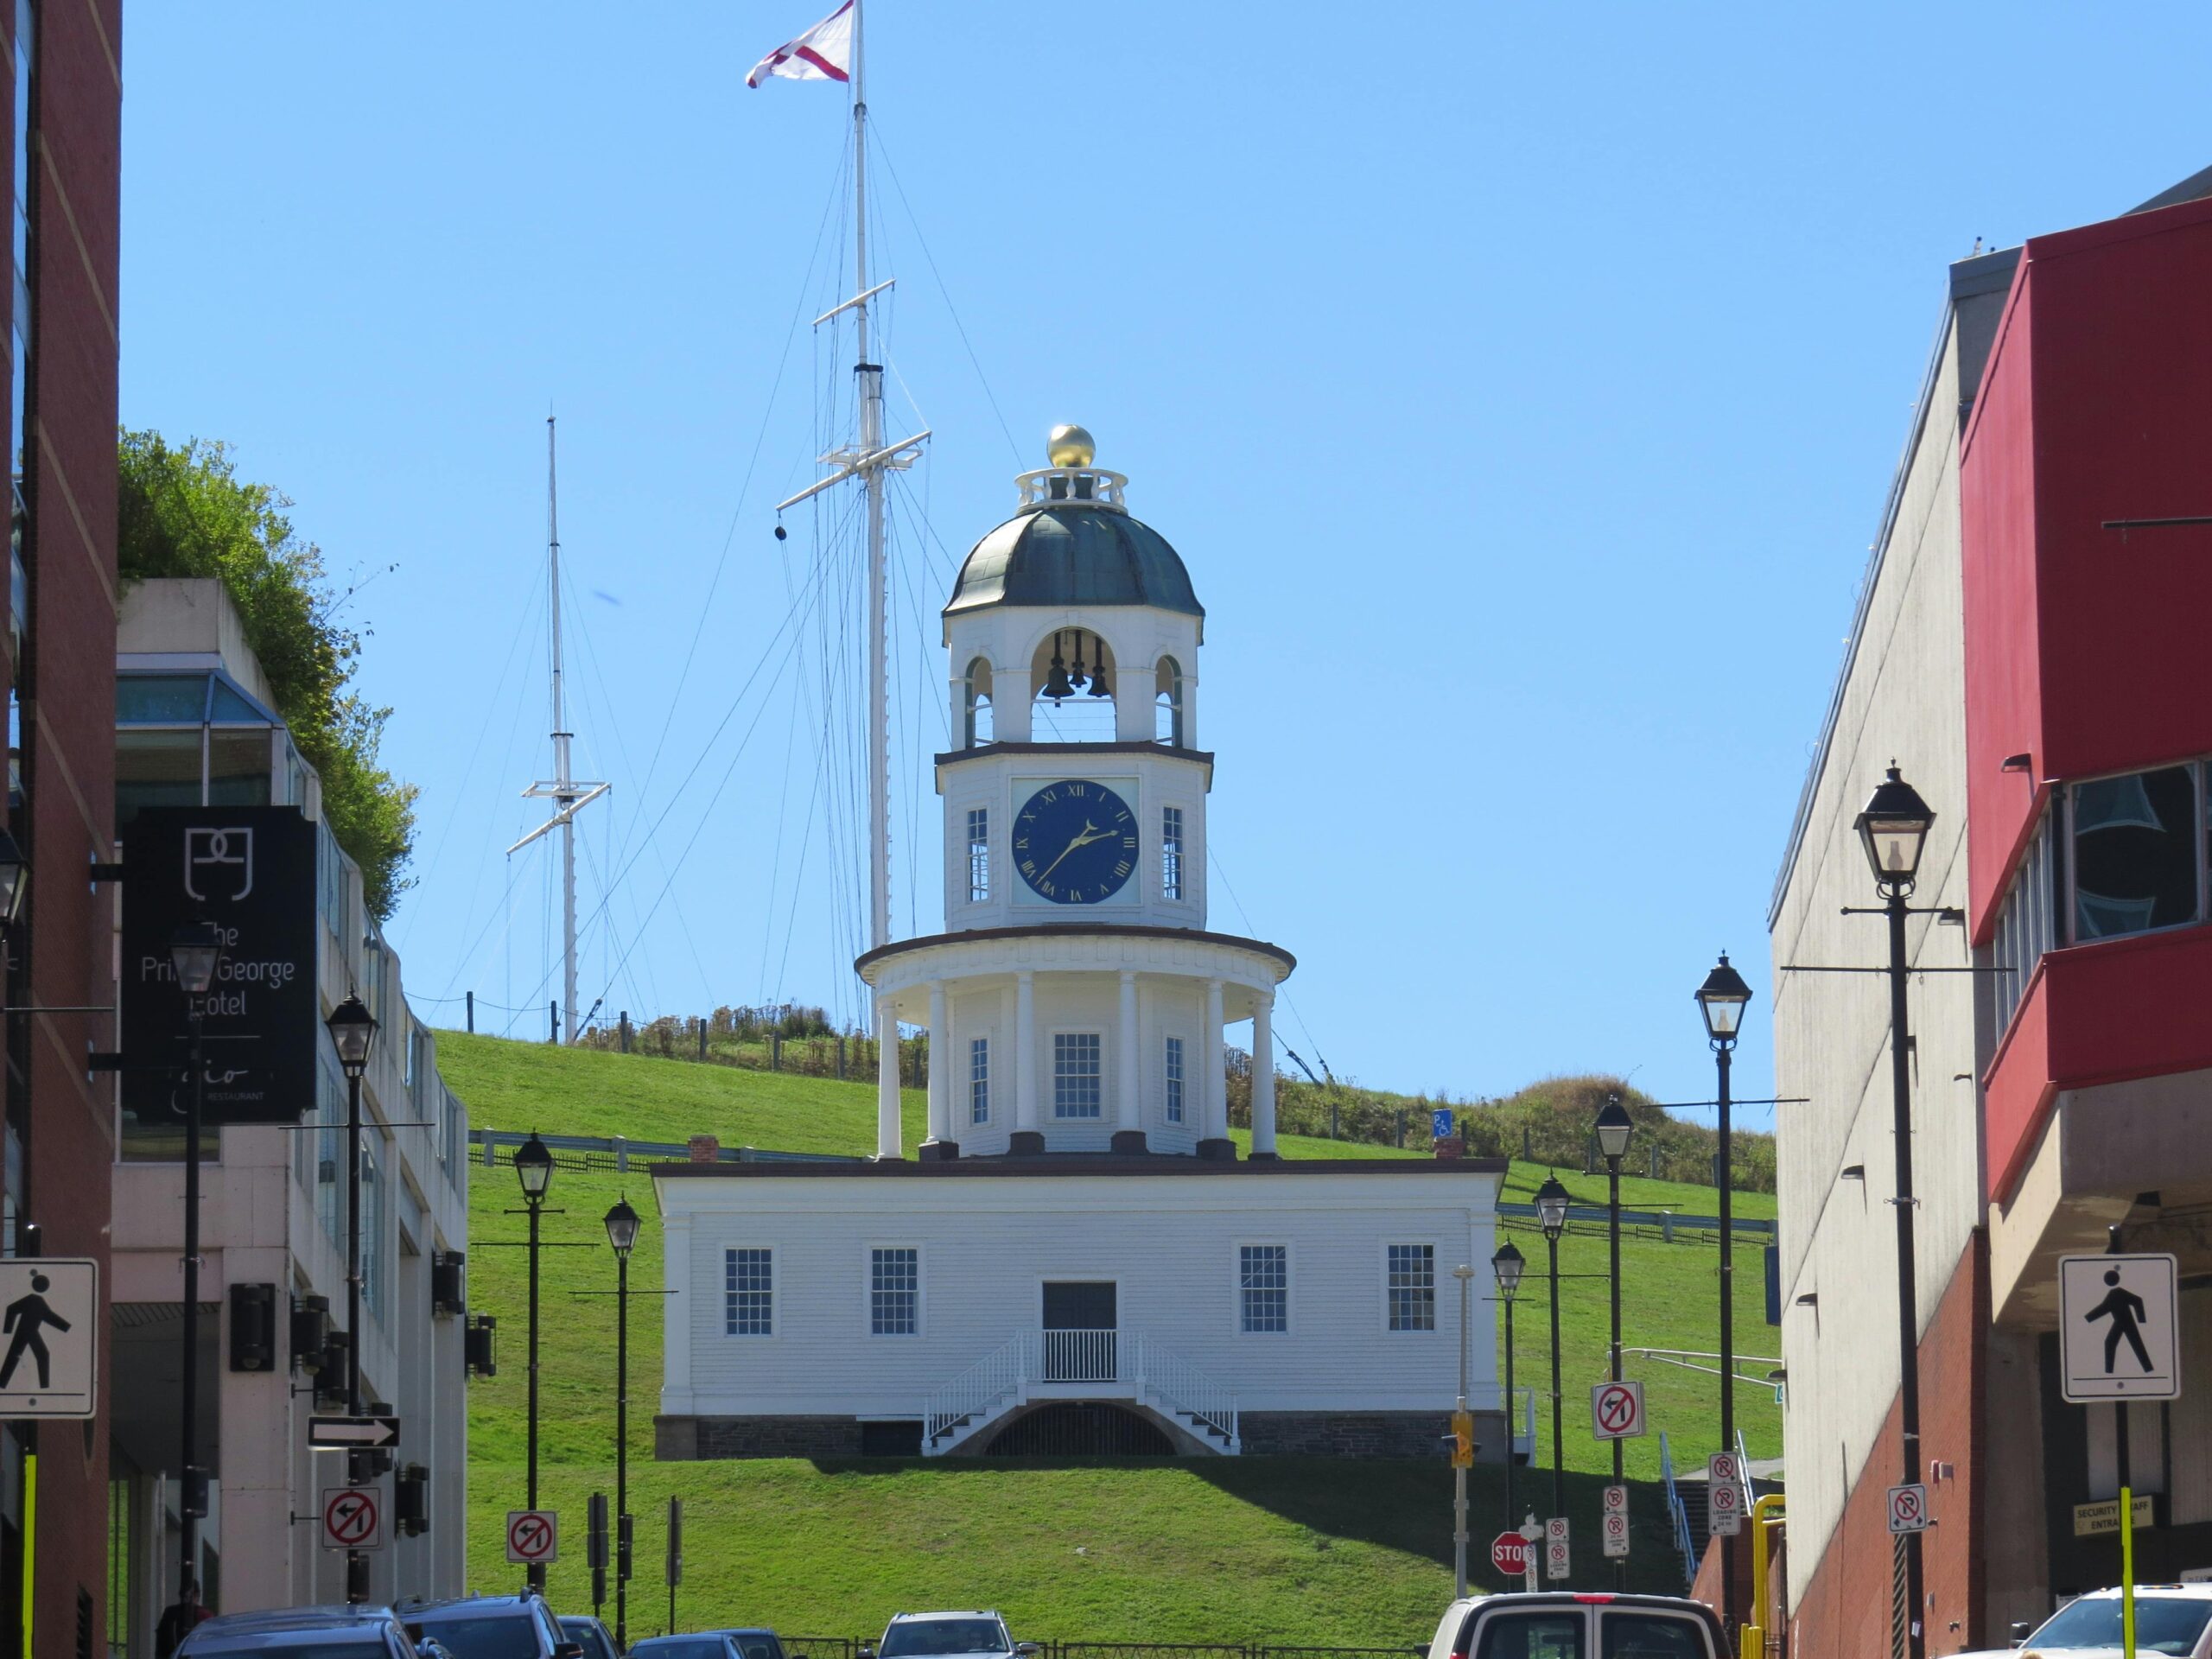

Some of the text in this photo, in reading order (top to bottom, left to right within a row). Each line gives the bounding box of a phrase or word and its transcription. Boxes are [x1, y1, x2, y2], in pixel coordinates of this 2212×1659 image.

[1041, 790, 1057, 805] XI
[1068, 785, 1084, 797] XII
[1022, 810, 1036, 823] X
[1115, 810, 1129, 823] II
[1016, 837, 1028, 849] IX
[1123, 836, 1135, 849] III
[1071, 889, 1083, 901] VI
[1100, 883, 1109, 895] V
[199, 921, 239, 946] he
[216, 956, 296, 989] George
[207, 1091, 264, 1102] RESTAURANT
[2077, 1505, 2117, 1519] SECURITY
[2090, 1515, 2135, 1530] ENTRAE
[1495, 1545, 1526, 1561] STO
